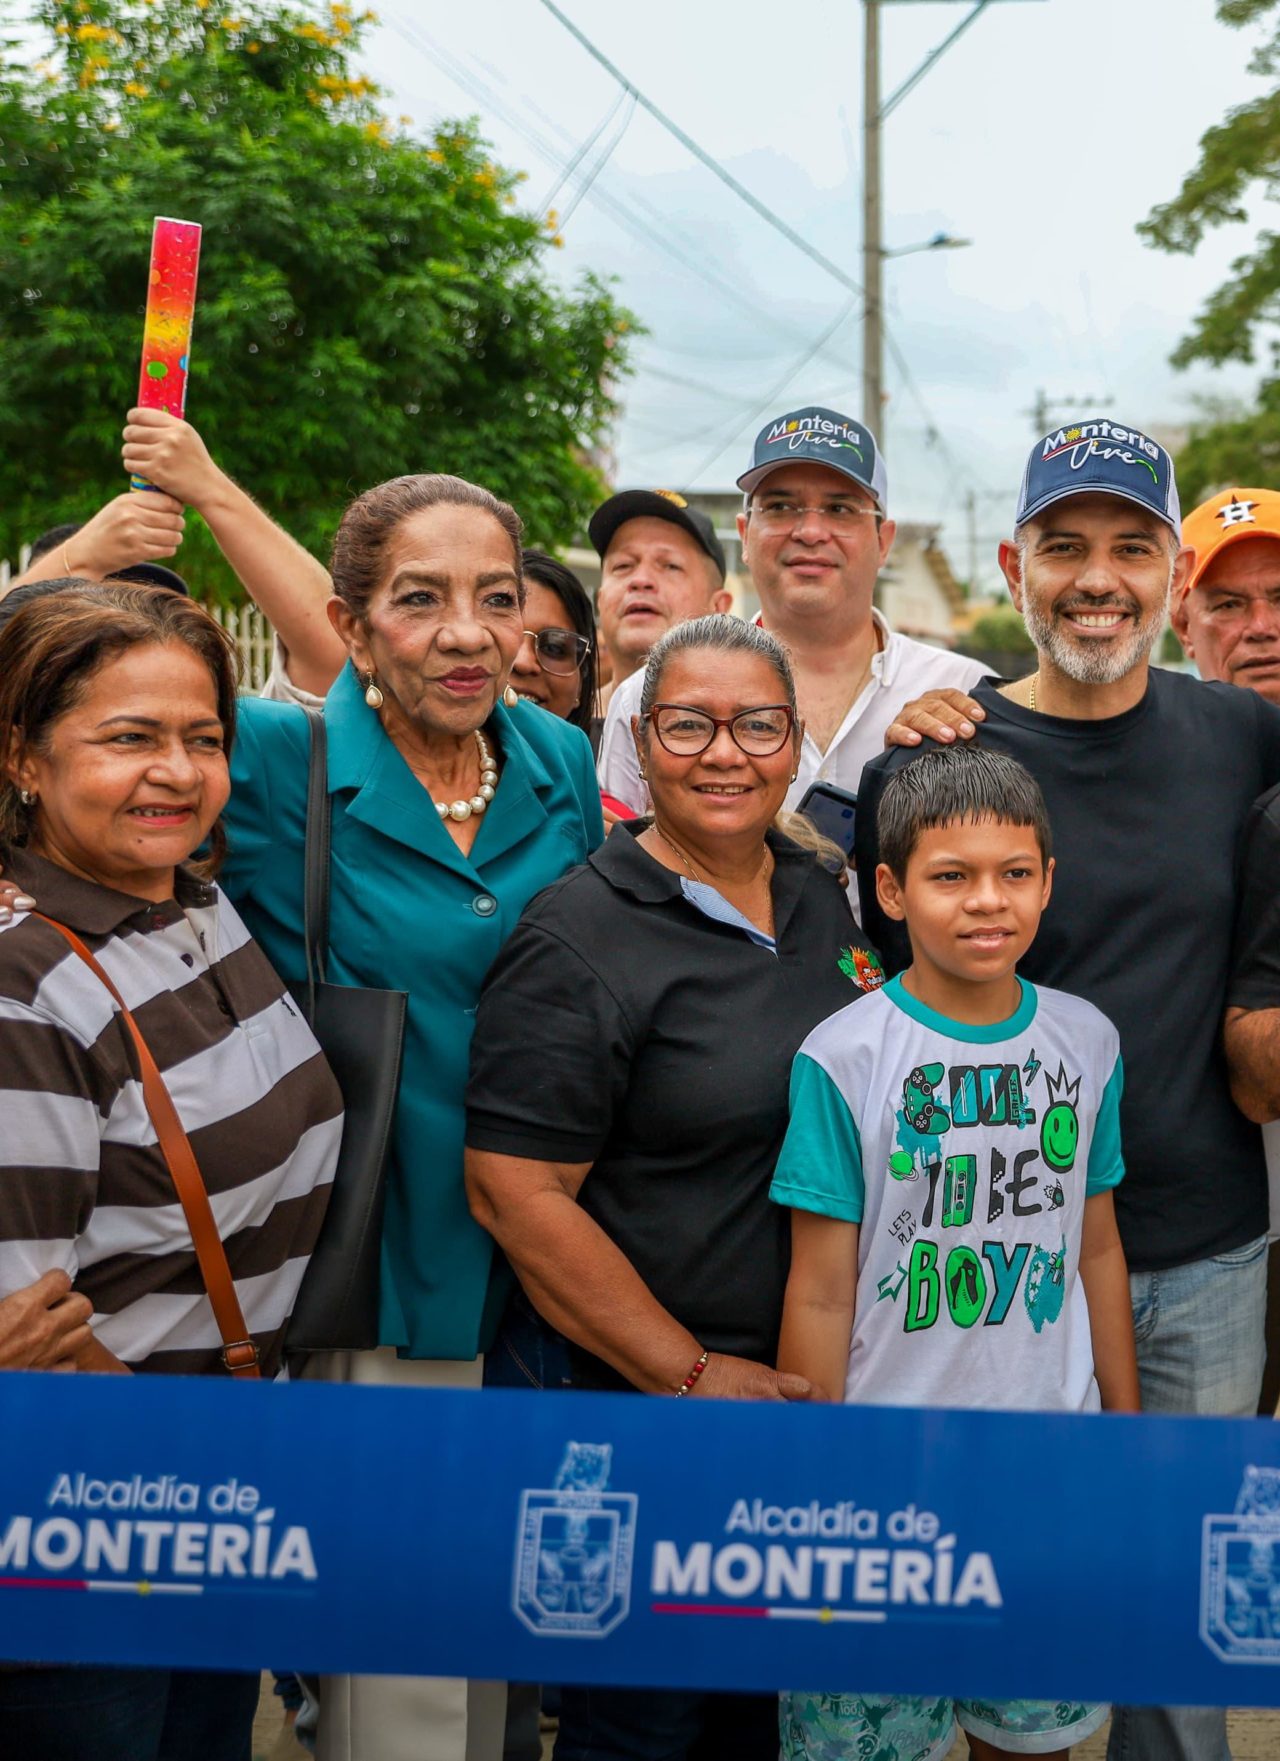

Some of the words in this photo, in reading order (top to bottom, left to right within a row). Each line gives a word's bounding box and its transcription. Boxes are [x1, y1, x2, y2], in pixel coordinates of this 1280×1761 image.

[987, 1147, 1043, 1224] BE
[888, 1209, 912, 1236] LETS
[897, 1219, 917, 1247] PLAY
[903, 1238, 1032, 1334] BOY
[47, 1472, 200, 1512] Alcaldía
[208, 1478, 260, 1515] de
[725, 1498, 879, 1540] Alcaldía
[887, 1504, 940, 1543] de
[652, 1533, 1003, 1608] MONTERÍA
